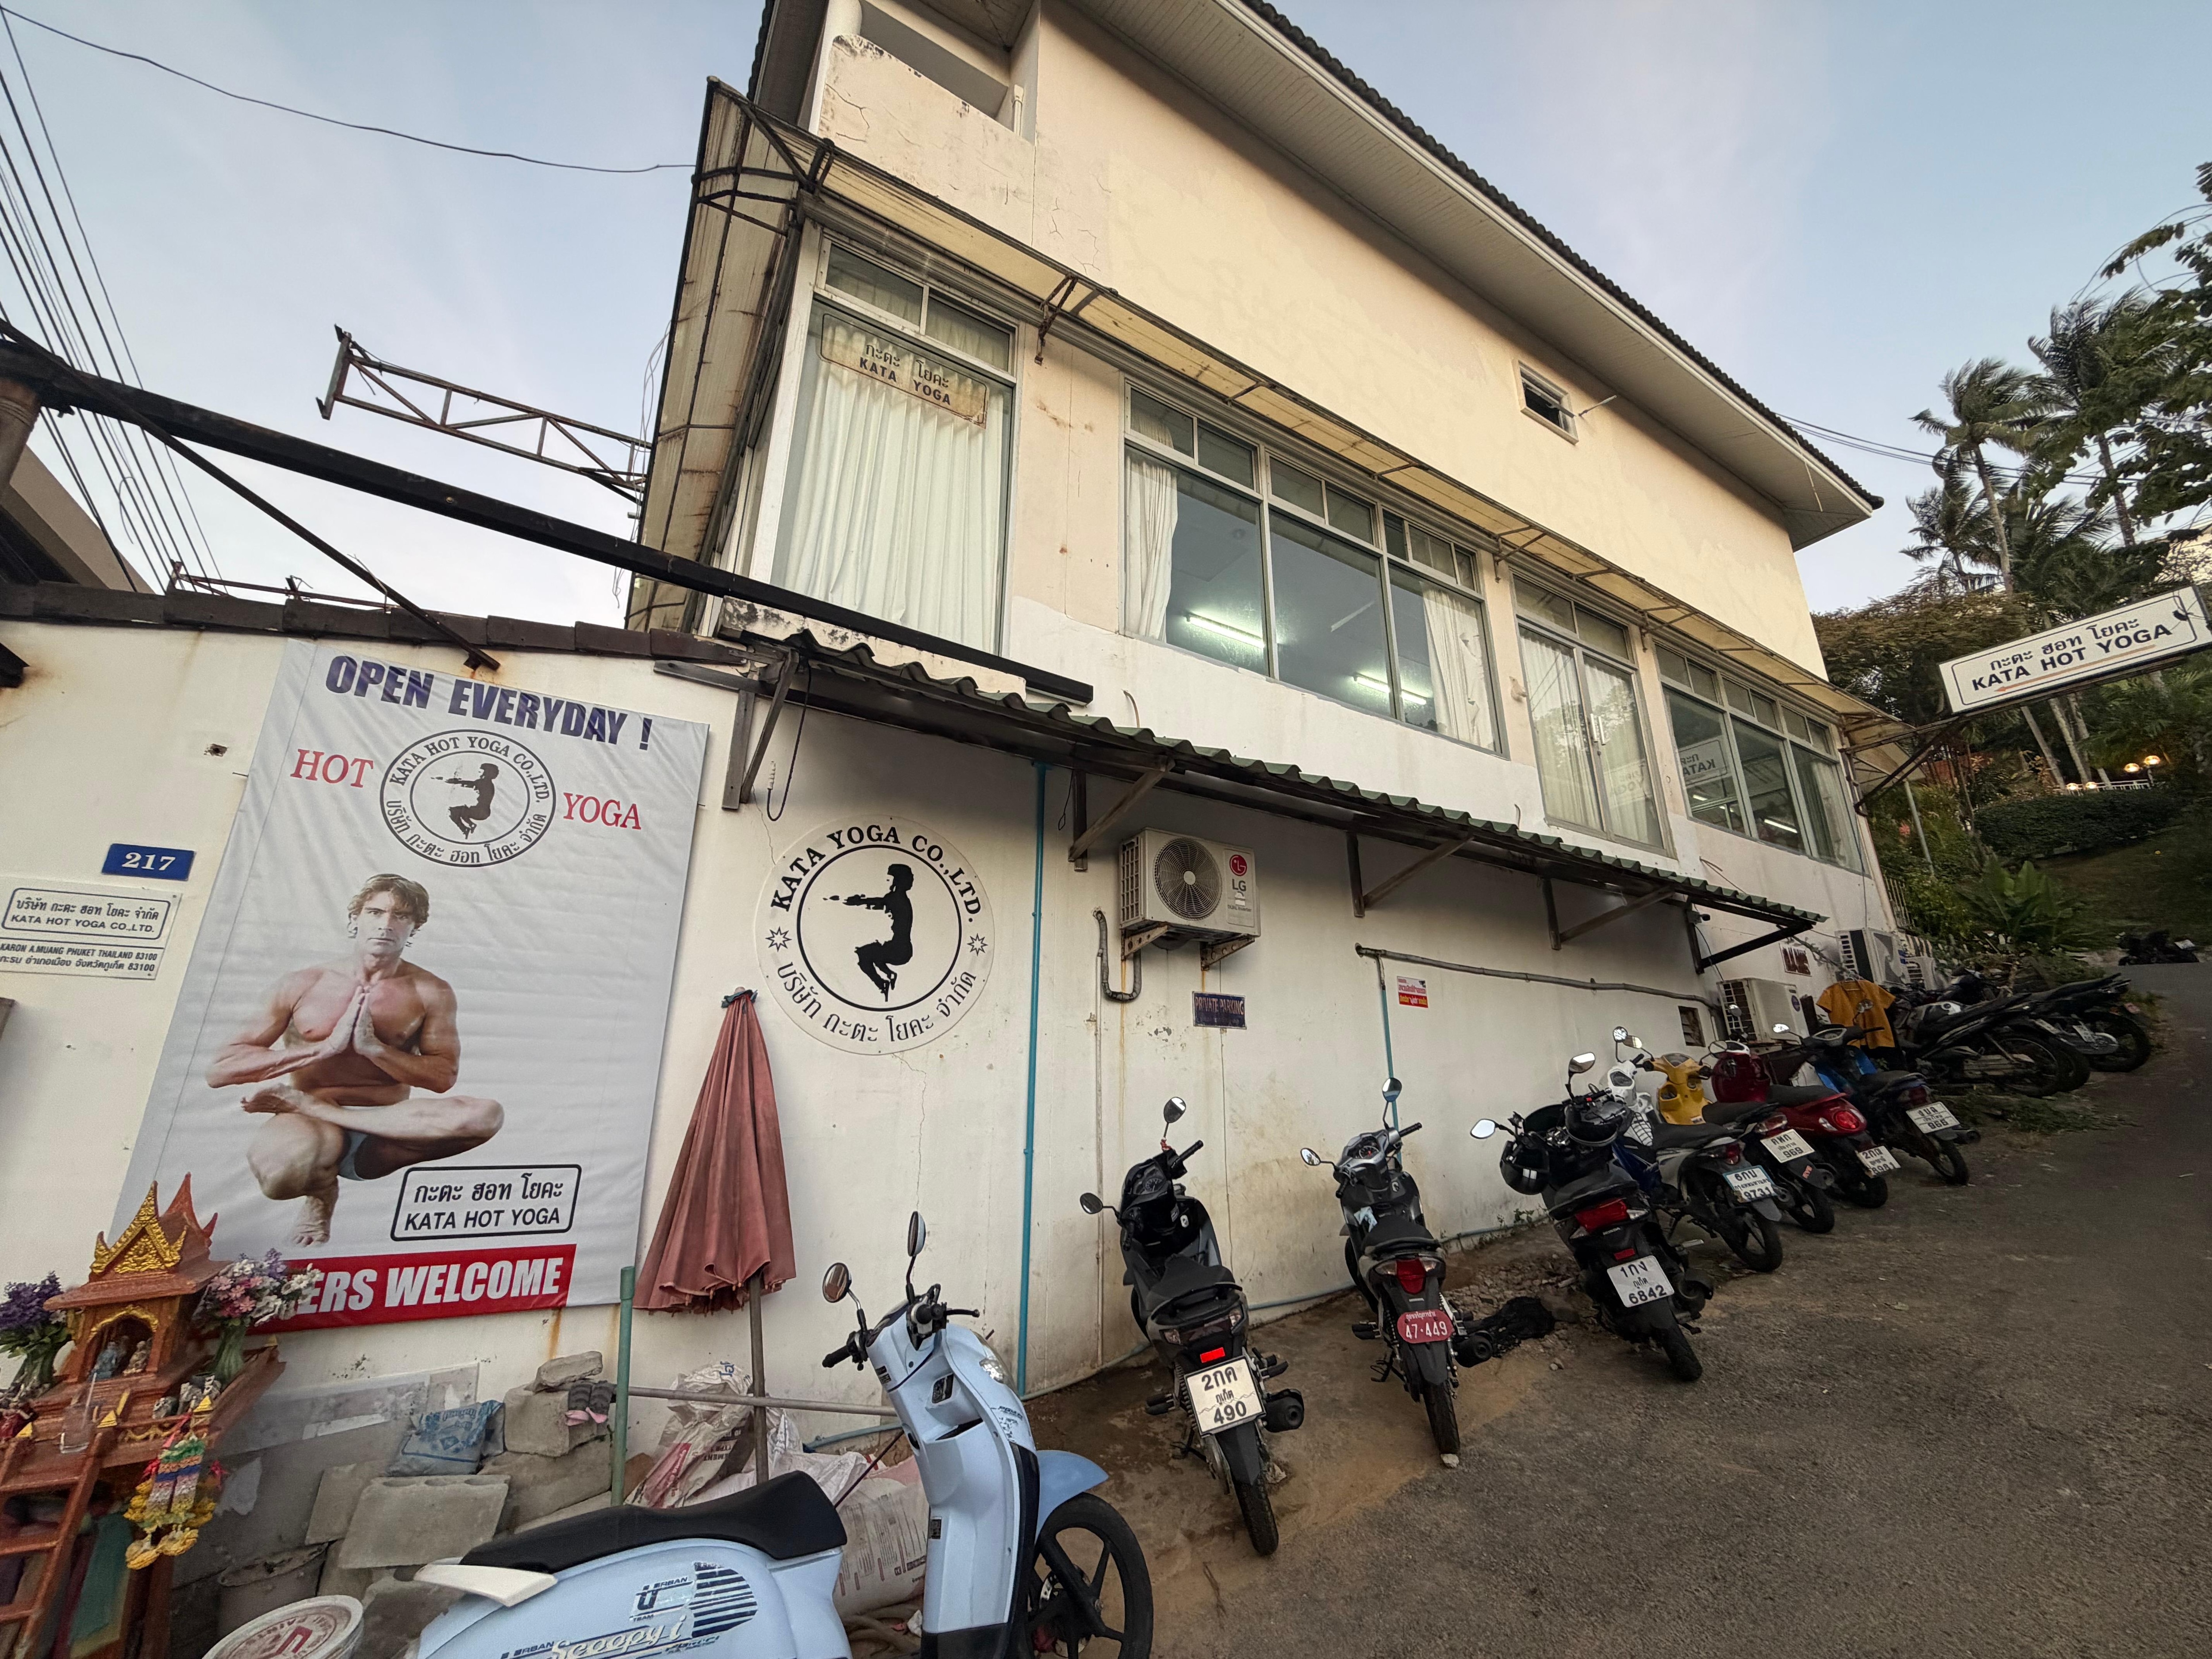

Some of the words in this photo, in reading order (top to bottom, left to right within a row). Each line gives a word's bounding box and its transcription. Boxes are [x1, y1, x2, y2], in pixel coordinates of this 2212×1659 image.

[866, 345, 900, 368] กะตะ
[916, 360, 949, 388] โยคะ
[860, 357, 897, 382] KATA
[913, 380, 950, 405] YOGA
[1990, 650, 2033, 670] กะตะ
[2041, 636, 2082, 655] ฮอท
[2086, 619, 2139, 640] โยคะ
[1971, 666, 2031, 691] KATA
[2040, 647, 2087, 671] HOT
[2096, 624, 2172, 653] YOGA
[326, 656, 433, 709] OPEN
[448, 680, 628, 745] EVERYDAY
[639, 718, 653, 750] !
[290, 749, 374, 787] HOT
[389, 752, 426, 786] KATA
[424, 737, 460, 756] HOT
[467, 736, 510, 757] YOGA
[563, 794, 641, 830] YOGA
[386, 800, 411, 833] บริษัท
[405, 834, 444, 857] กะตะ
[450, 850, 480, 863] ฮอท
[484, 842, 520, 861] โยคะ
[519, 814, 547, 842] จำกัด
[122, 852, 176, 871] 217
[771, 848, 826, 912] KATA
[826, 825, 901, 850] YOGA
[1232, 879, 1246, 891] LG
[16, 897, 46, 911] บริษัท
[50, 902, 75, 913] กะตะ
[81, 905, 102, 915] ฮอท
[106, 903, 131, 917] โยคะ
[134, 906, 159, 920] จำกัด
[11, 915, 41, 924] KATA
[75, 919, 106, 929] YOGA
[66, 948, 96, 957] PHUKET
[98, 950, 133, 959] THAILAND
[135, 952, 157, 960] 83100
[127, 962, 155, 972] 83100
[777, 962, 822, 1018] บริษัท
[822, 1014, 878, 1041] กะตะ
[886, 1014, 934, 1041] โยคะ
[936, 972, 976, 1018] จำกัด
[1195, 997, 1219, 1013] PRIVATE
[1220, 998, 1244, 1015] PARKING
[1927, 1119, 1949, 1129] 966
[1783, 1147, 1804, 1158] 969
[414, 1184, 463, 1203] กะตะ
[472, 1183, 512, 1201] ฮอท
[521, 1173, 564, 1200] โยคะ
[1743, 1187, 1771, 1200] 9731
[404, 1211, 456, 1231] KATA
[464, 1210, 504, 1229] HOT
[511, 1208, 560, 1225] YOGA
[384, 1258, 565, 1308] WELCOME
[1629, 1285, 1667, 1304] 6842
[1216, 1389, 1234, 1406] ภูเก็ต
[1214, 1401, 1247, 1425] 490
